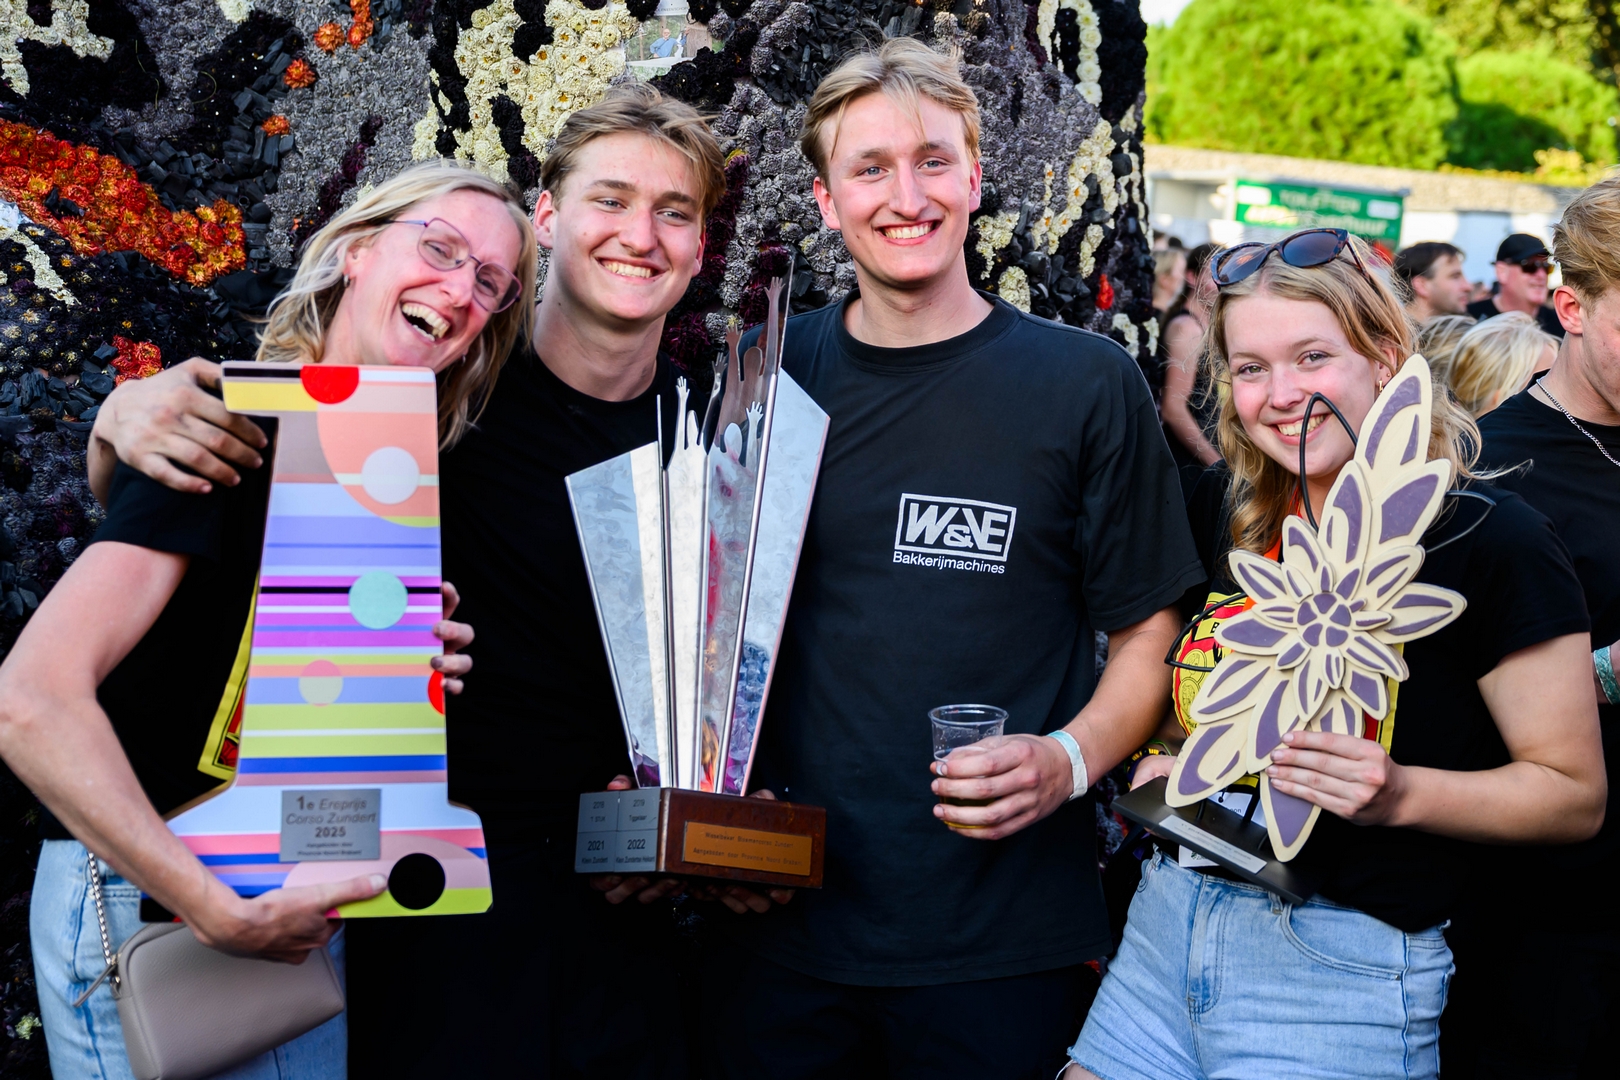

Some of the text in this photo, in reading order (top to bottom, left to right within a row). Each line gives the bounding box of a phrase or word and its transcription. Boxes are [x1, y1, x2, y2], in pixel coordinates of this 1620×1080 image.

[905, 502, 1008, 552] W&VE
[893, 551, 1005, 574] Bakkerijmachines
[296, 795, 367, 812] 1e Ereprijs
[286, 812, 377, 825] Corso Zundert
[315, 826, 346, 838] 2025
[587, 840, 605, 851] 2021
[627, 838, 646, 850] 2022
